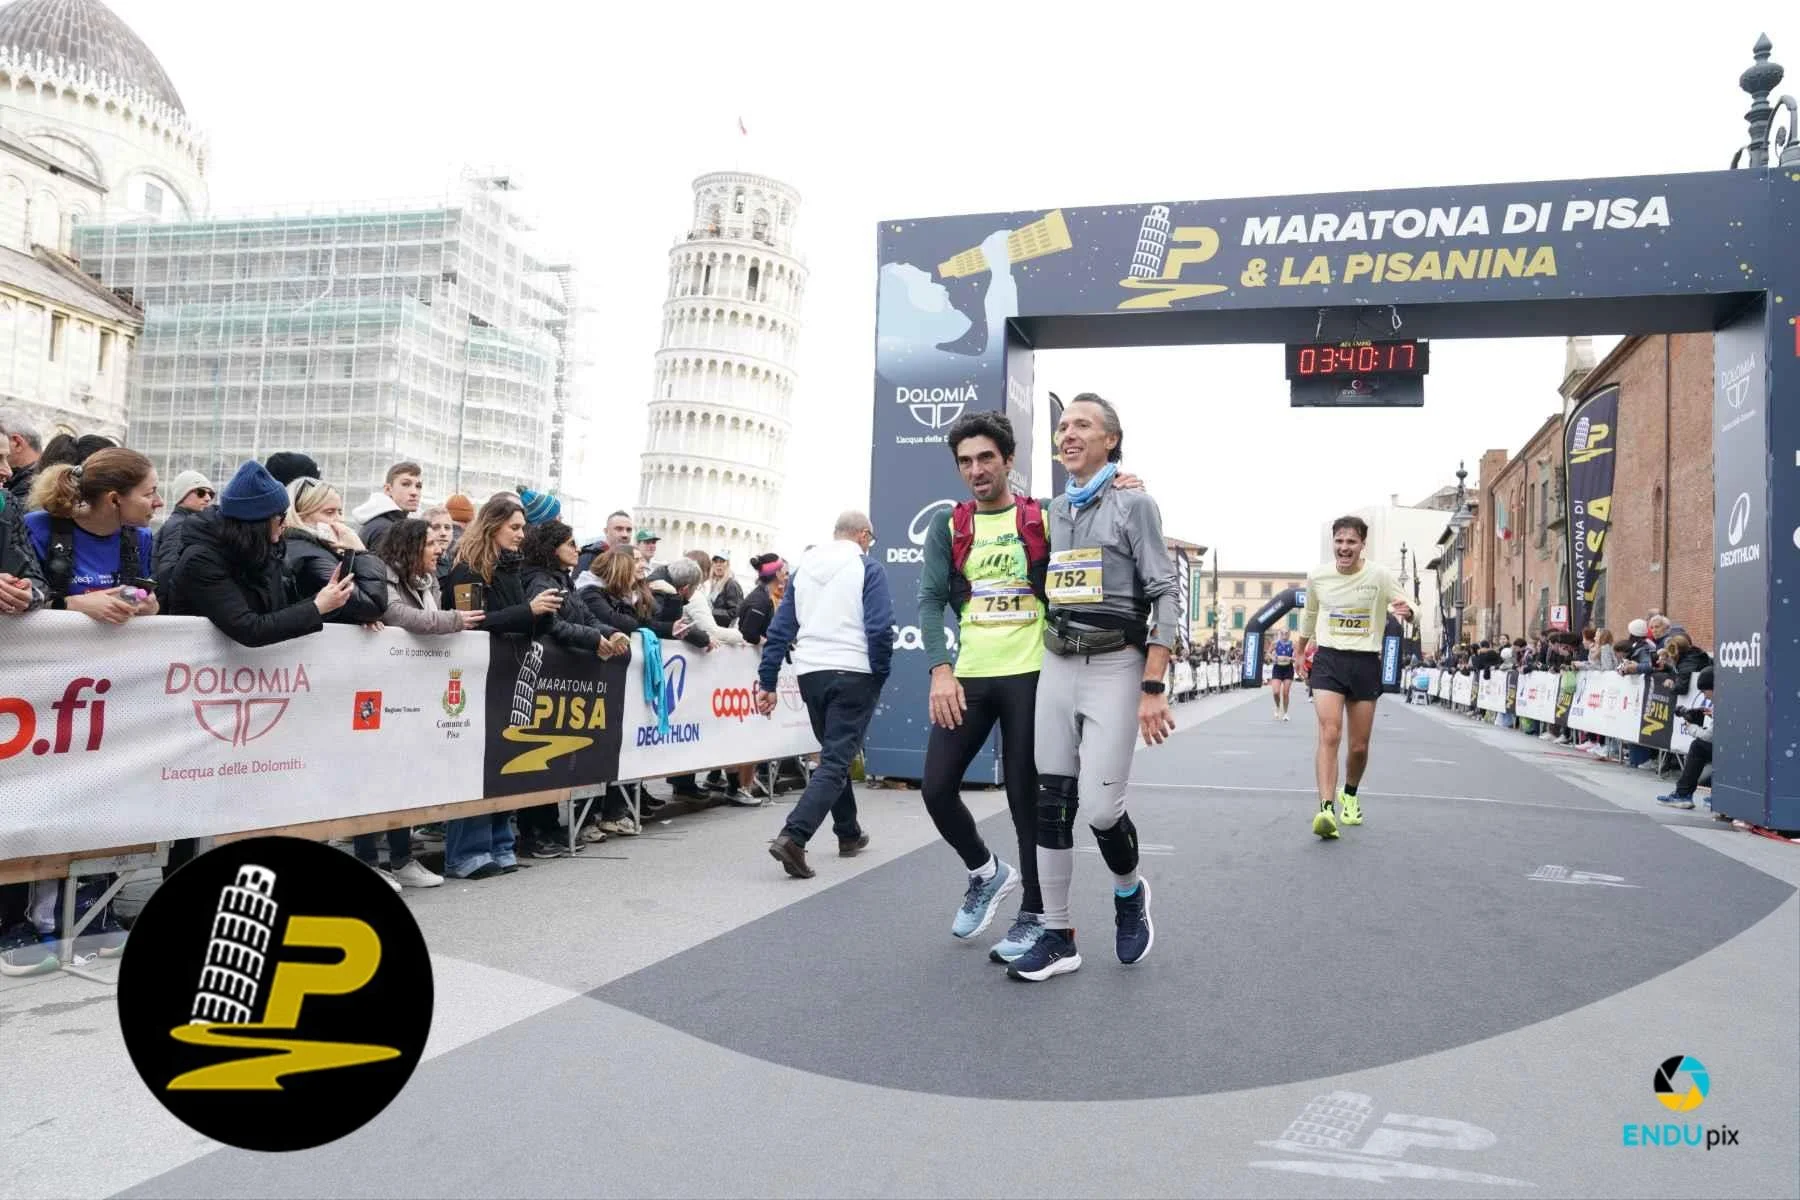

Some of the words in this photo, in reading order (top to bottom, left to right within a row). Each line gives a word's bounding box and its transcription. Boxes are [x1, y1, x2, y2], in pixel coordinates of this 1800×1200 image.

[1240, 205, 1490, 246] MARATONA
[1502, 202, 1552, 234] DI
[1562, 196, 1670, 231] PISA
[1240, 257, 1268, 287] &
[1279, 255, 1331, 286] LA
[1343, 246, 1557, 284] PISANINA
[1300, 345, 1414, 373] 03:40:17
[896, 384, 979, 403] DOLOMIA
[1574, 499, 1584, 513] DI
[1575, 520, 1585, 602] MARATONA
[1719, 544, 1760, 568] DECATHLON
[1054, 570, 1087, 588] 752
[985, 596, 1021, 612] 751
[1338, 619, 1361, 629] 702
[390, 647, 403, 656] Con
[1719, 632, 1761, 673] coop.fi
[165, 662, 311, 695] DOLOMIA
[537, 677, 593, 693] MARATONA
[597, 682, 607, 693] DI
[533, 695, 607, 729] PISA
[436, 719, 463, 728] Comune
[464, 719, 470, 728] di
[446, 730, 460, 739] Pisa
[160, 766, 214, 781] L'acqua
[218, 762, 248, 776] delle
[251, 757, 306, 774] Dolomiti
